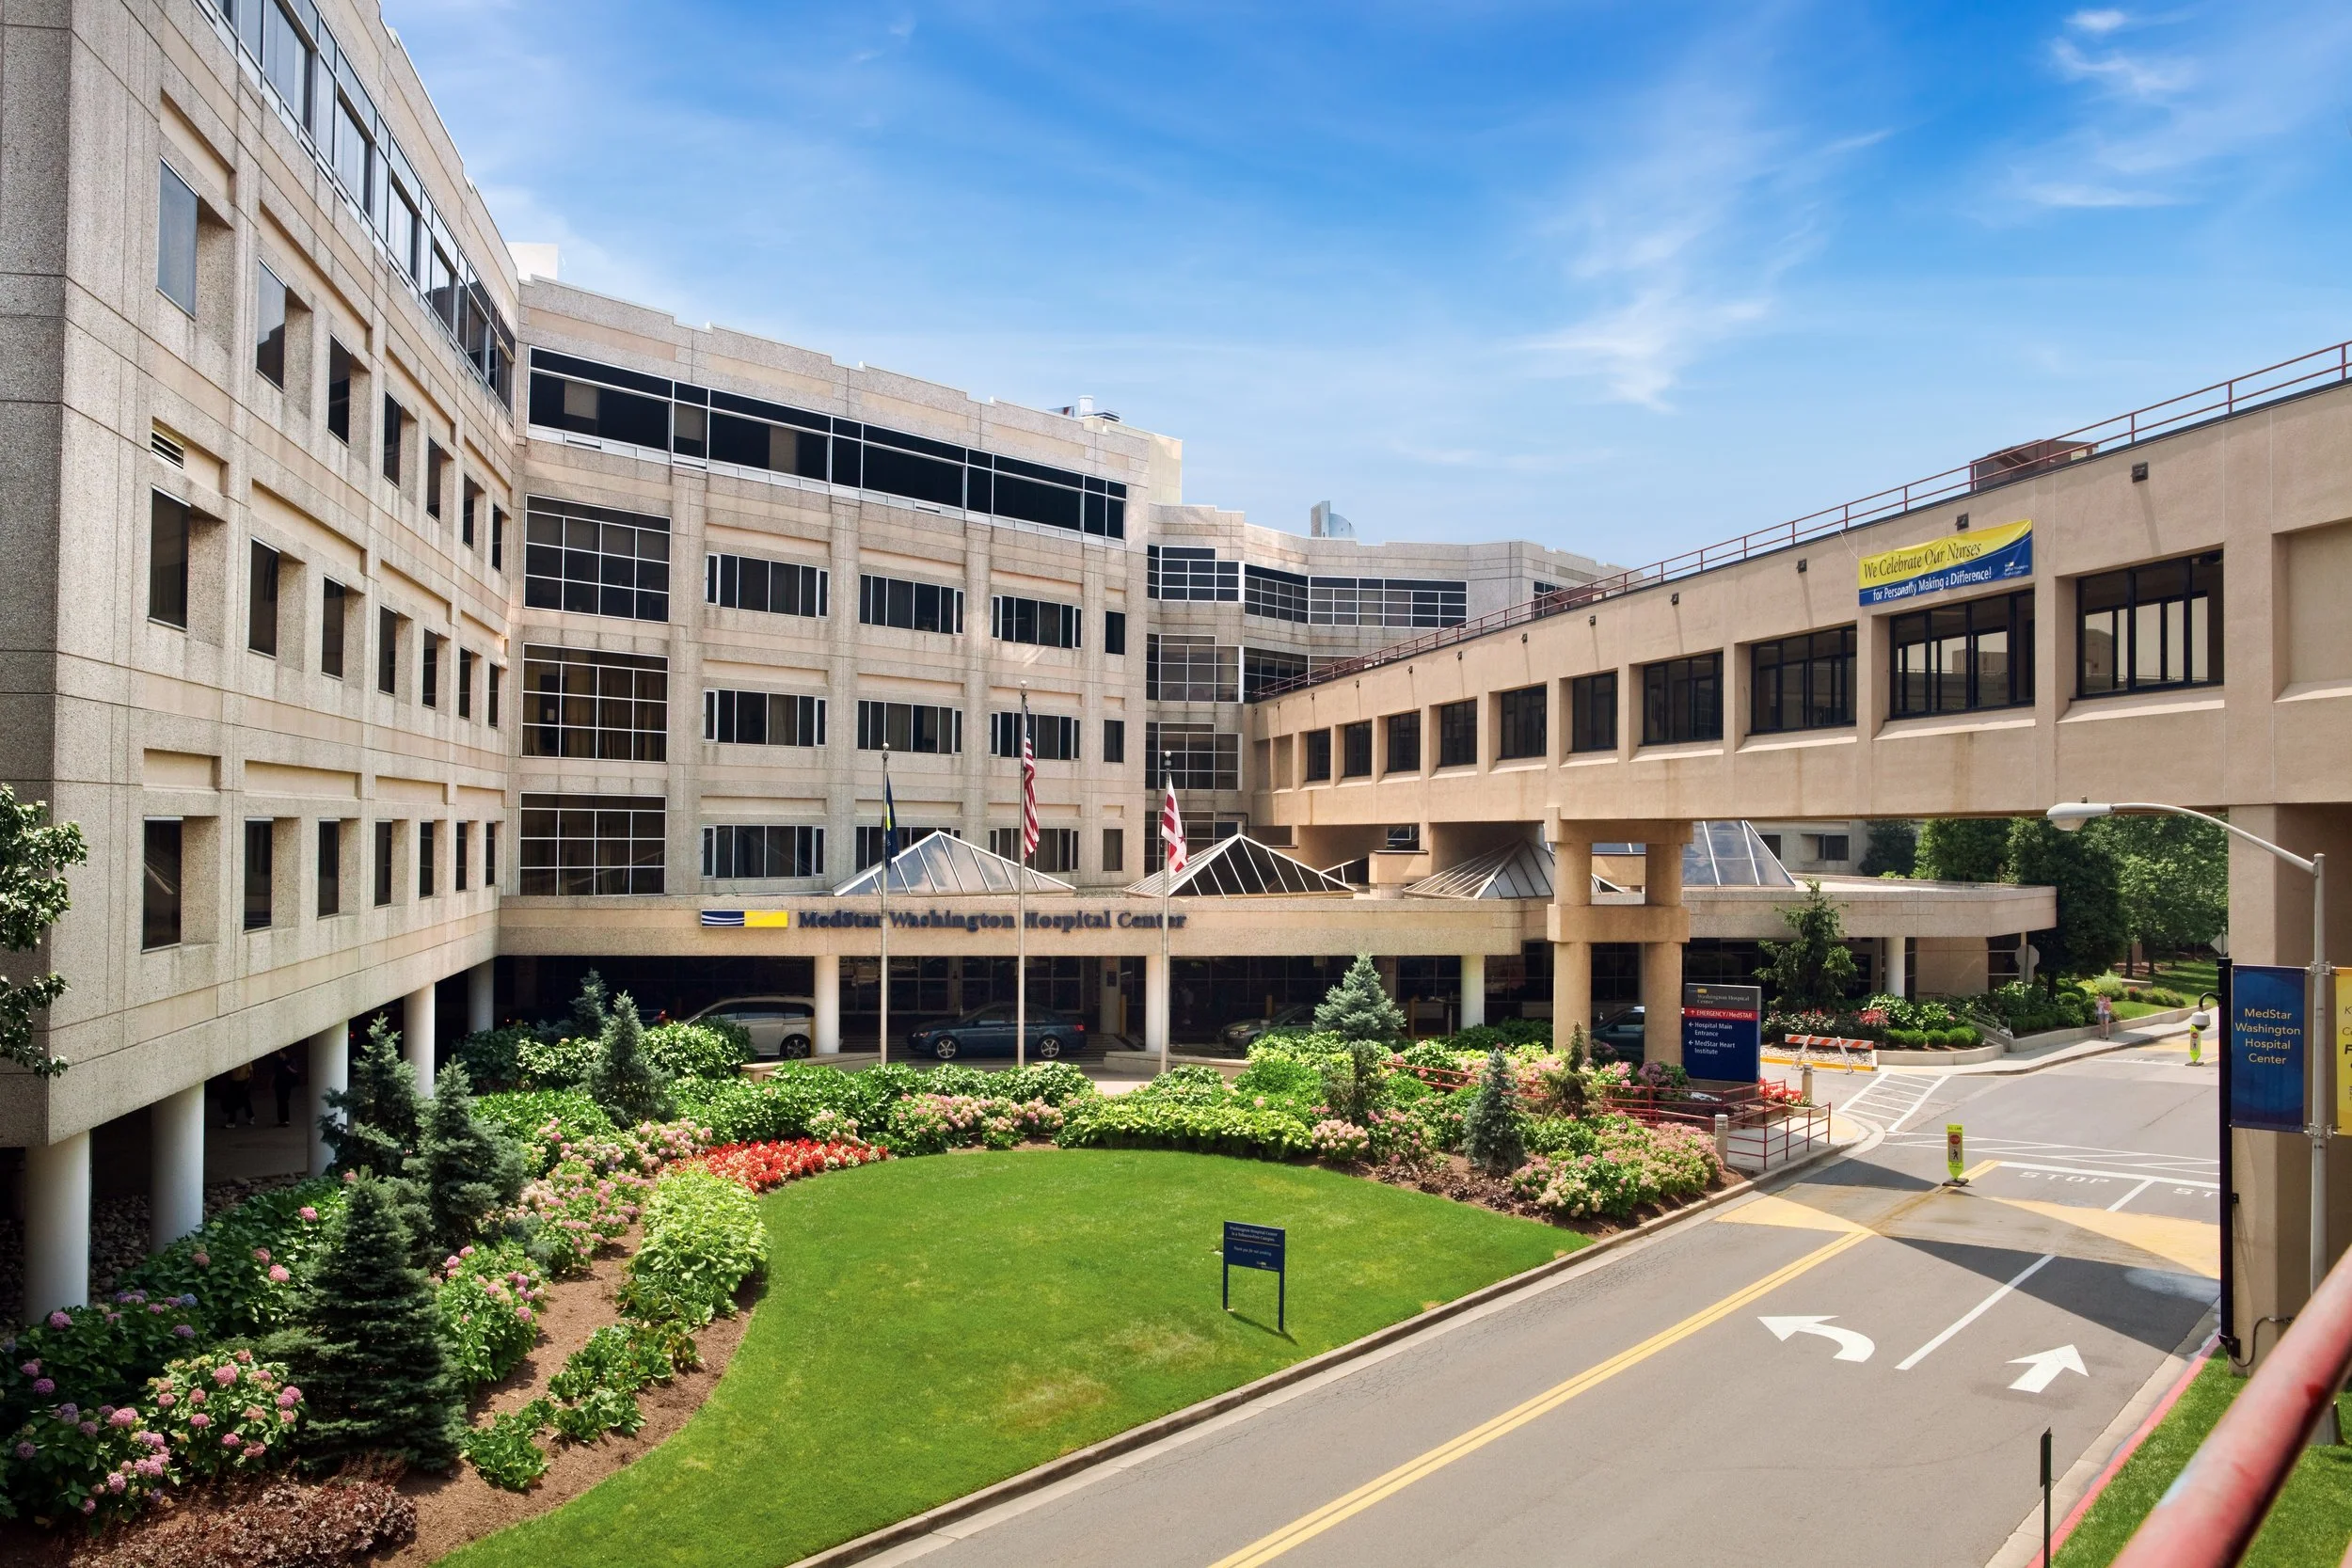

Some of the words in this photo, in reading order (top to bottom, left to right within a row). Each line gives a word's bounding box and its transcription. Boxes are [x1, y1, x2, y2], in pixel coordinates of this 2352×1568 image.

[1864, 563, 1877, 579] We
[1879, 556, 1922, 576] Celebrate
[1924, 549, 1945, 565] Our
[1947, 543, 1981, 561] Nurses
[1873, 590, 1883, 601] for
[1883, 583, 1916, 598] Personally
[1918, 577, 1945, 591] Making
[1945, 578, 1950, 586] a
[1950, 566, 1992, 585] Difference!
[799, 910, 882, 928] MedStar
[888, 910, 1016, 932] Washington
[1024, 910, 1112, 933] Hospital
[1117, 912, 1186, 928] Center
[2244, 1007, 2292, 1020] MedStar
[1694, 1022, 1717, 1030] Hospital
[2234, 1022, 2301, 1036] Washington
[2245, 1037, 2291, 1051] Hospital
[2248, 1053, 2287, 1065] Center
[2018, 1171, 2112, 1185] STOP
[2172, 1187, 2220, 1198] ST
